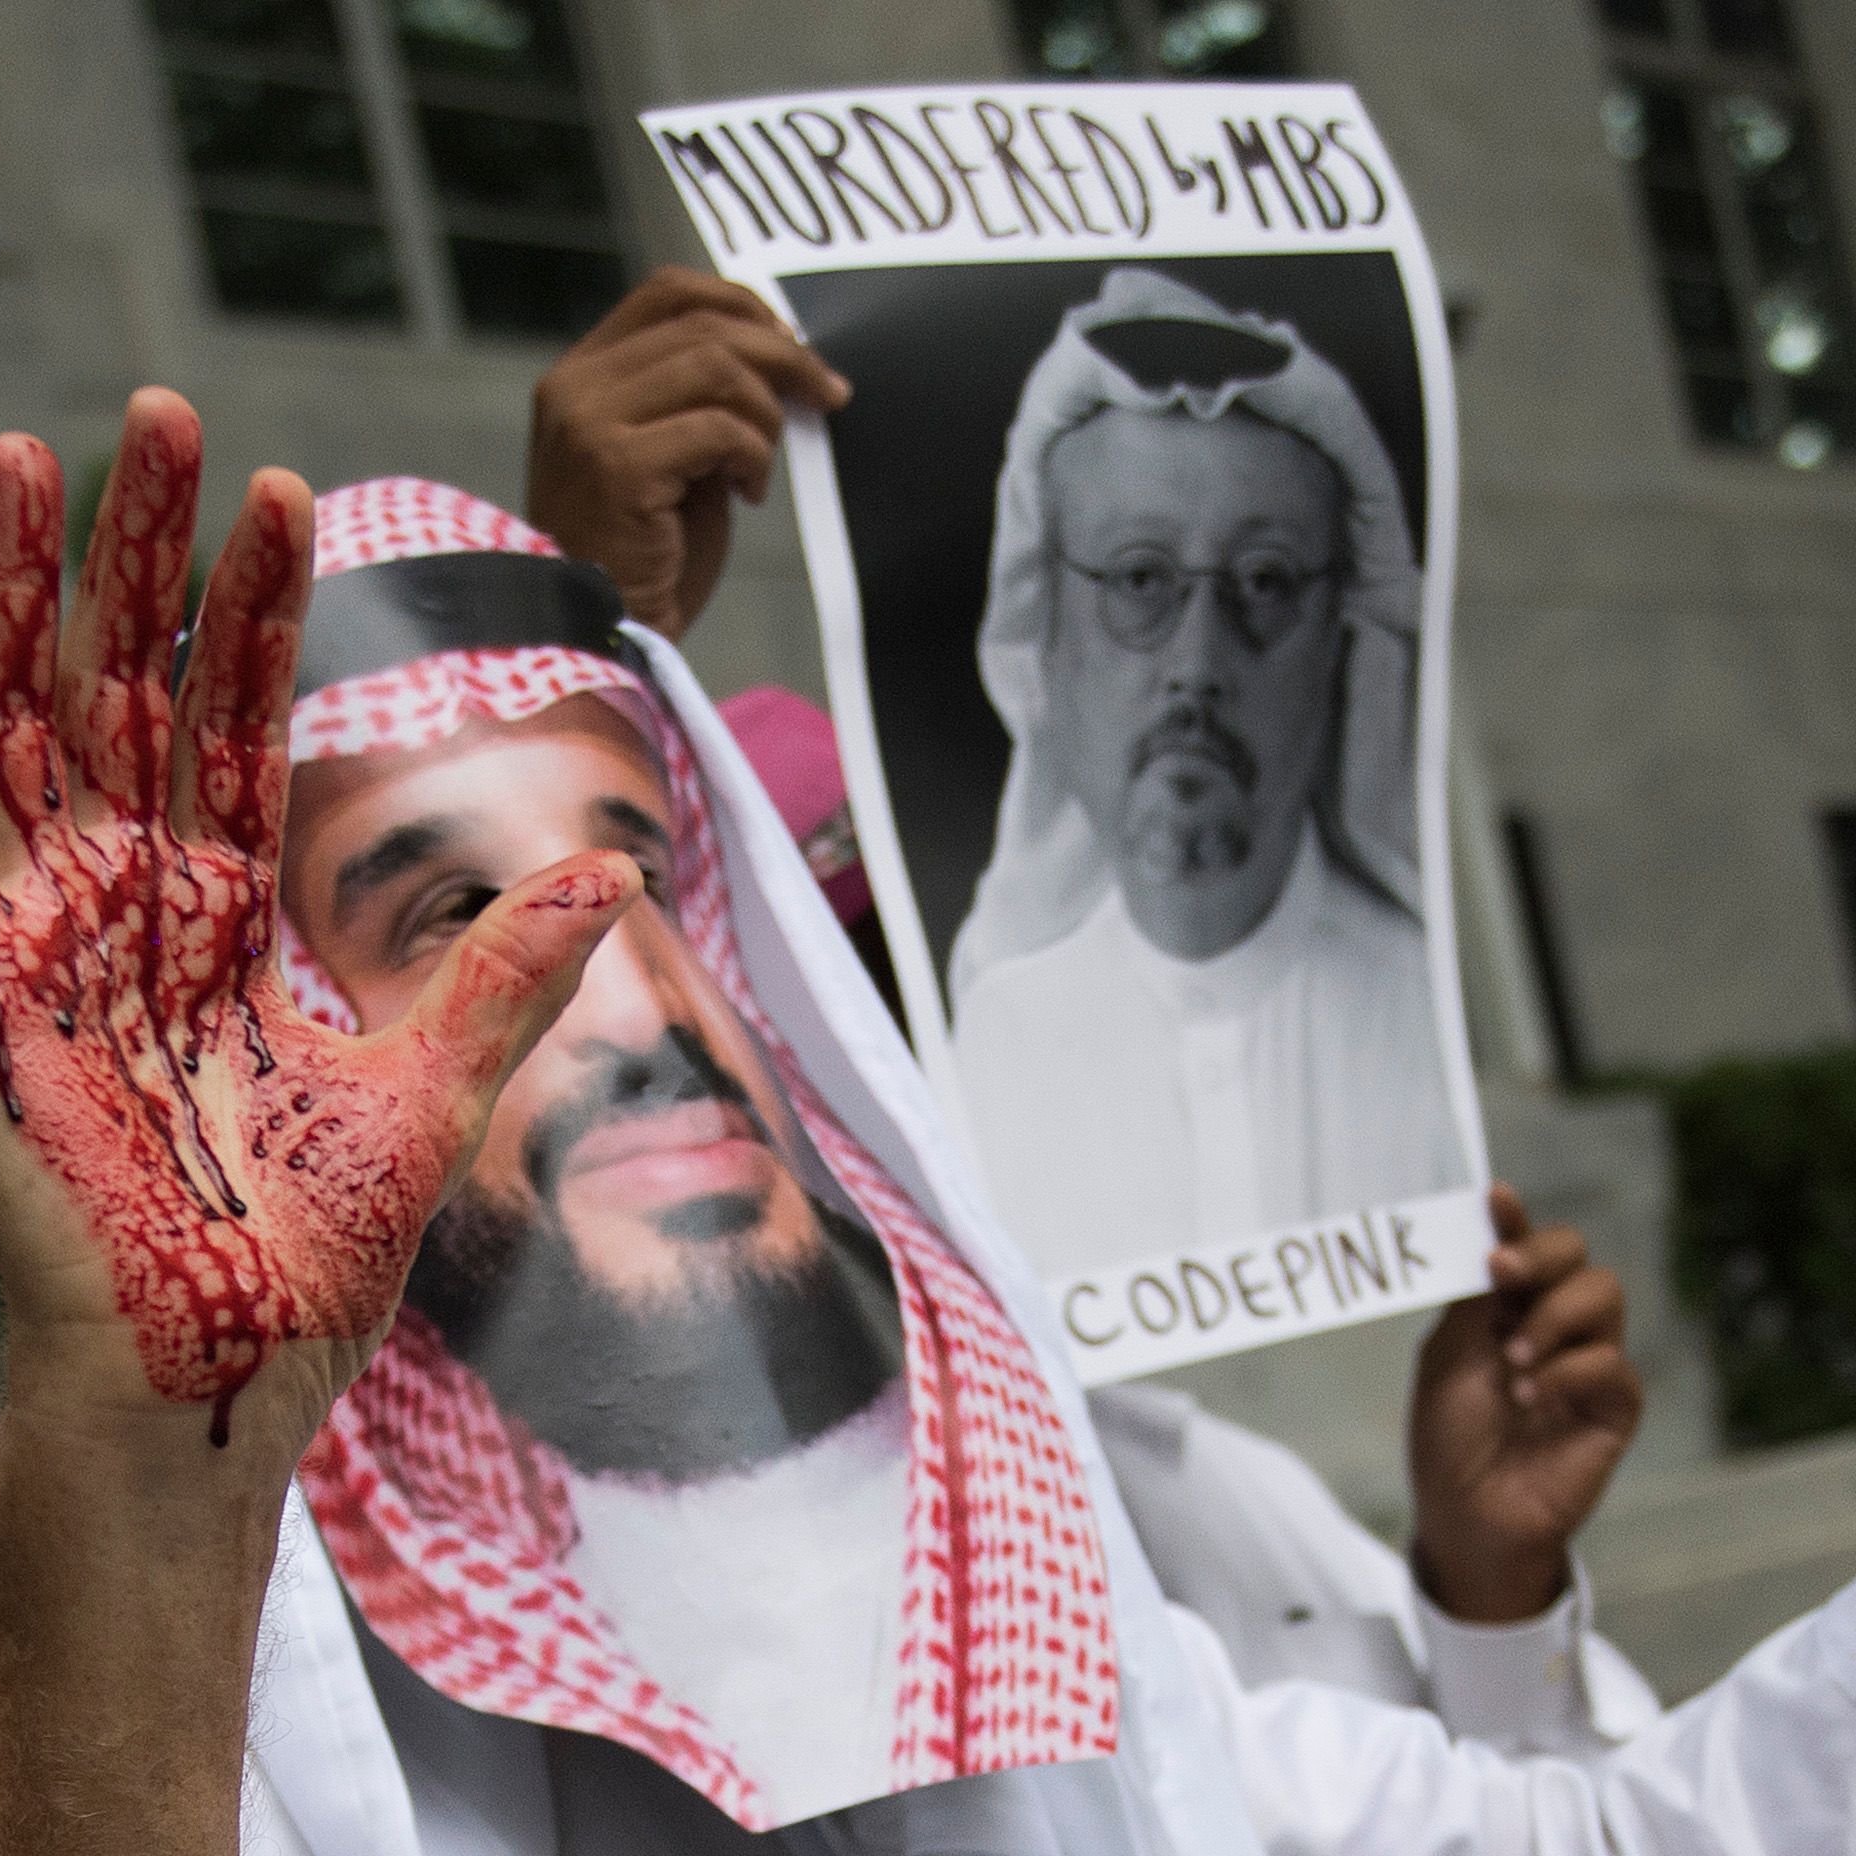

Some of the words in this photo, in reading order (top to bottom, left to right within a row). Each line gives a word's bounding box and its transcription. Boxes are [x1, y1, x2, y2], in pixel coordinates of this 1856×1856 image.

[659, 98, 1152, 256] MURDERED
[1145, 112, 1227, 215] by
[1220, 114, 1387, 231] MBS
[1061, 1210, 1431, 1347] CODEPINK
